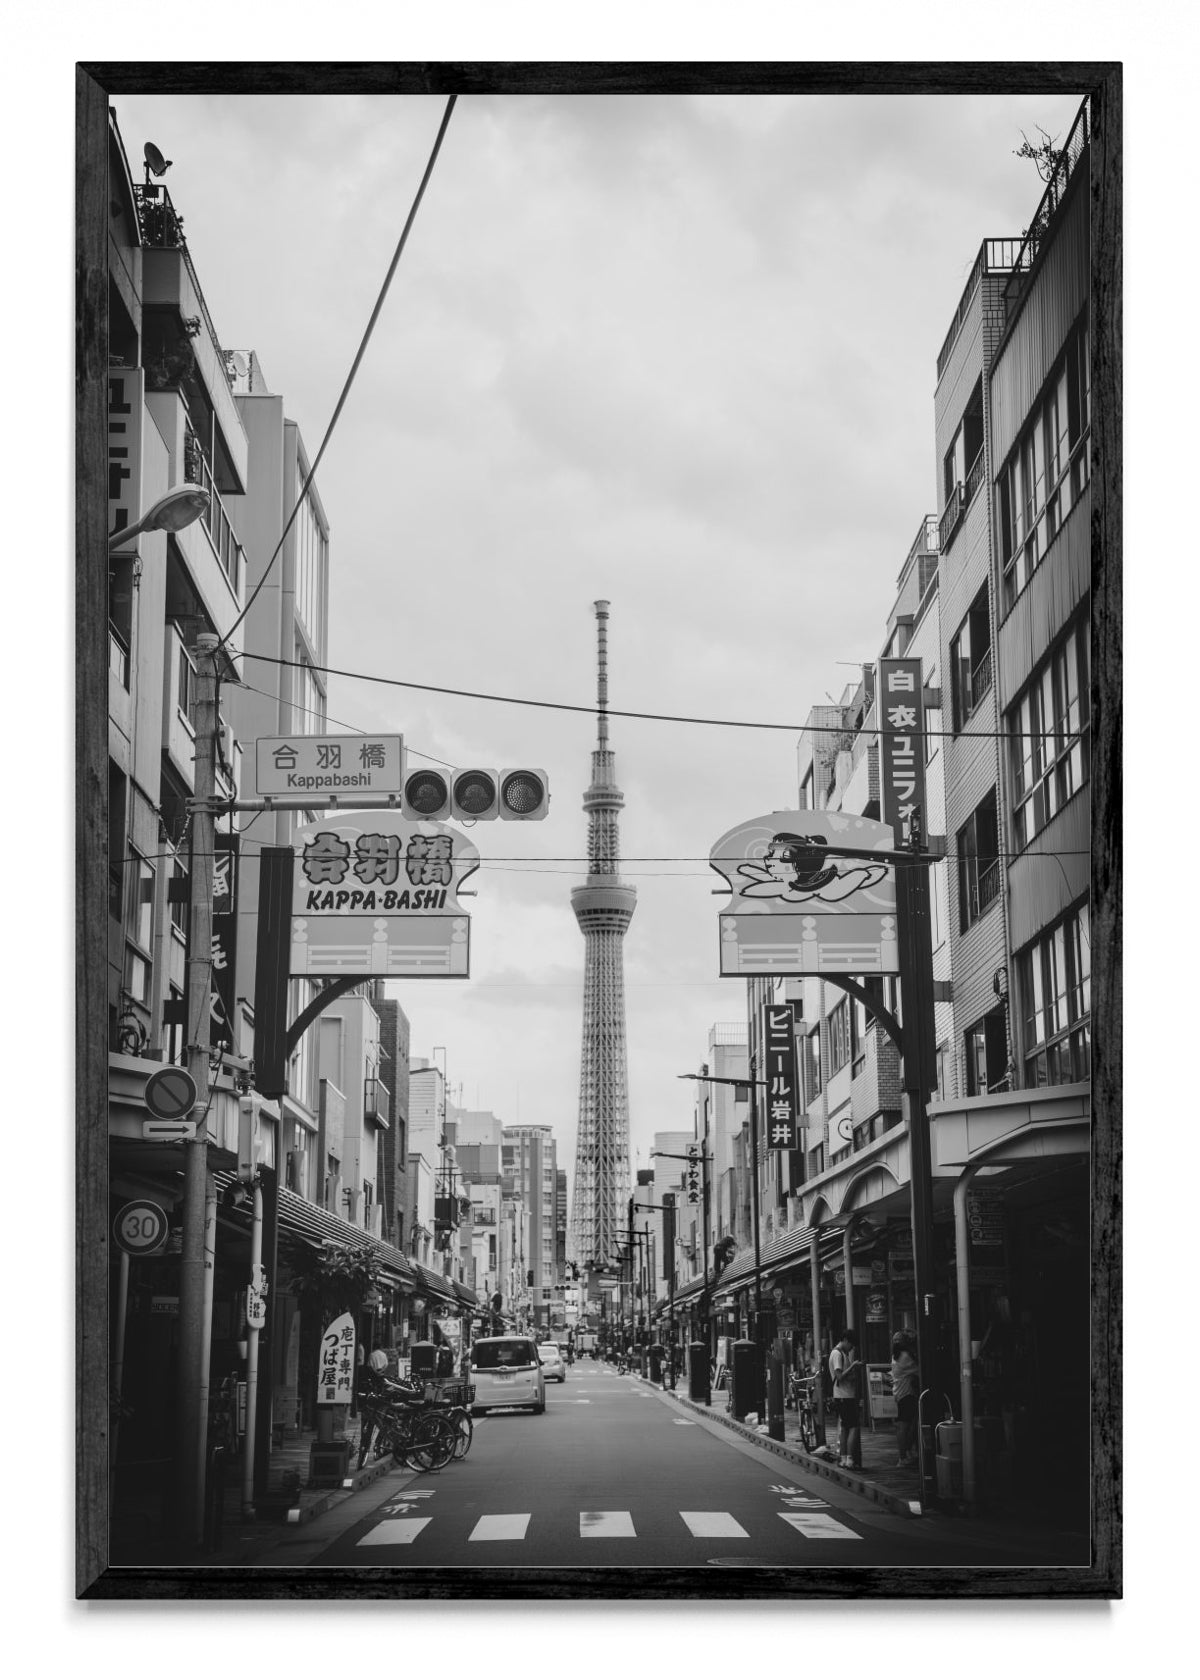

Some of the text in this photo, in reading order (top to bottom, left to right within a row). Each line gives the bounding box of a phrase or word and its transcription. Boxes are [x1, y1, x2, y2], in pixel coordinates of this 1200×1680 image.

[272, 743, 386, 770] 合羽橋
[287, 772, 372, 790] Kappabashi
[302, 831, 454, 887] 合羽橋
[768, 1008, 792, 1145] ビニール岩井
[126, 1215, 156, 1239] 30
[320, 1333, 340, 1386] つば屋
[337, 1325, 354, 1391] 庖丁専門
